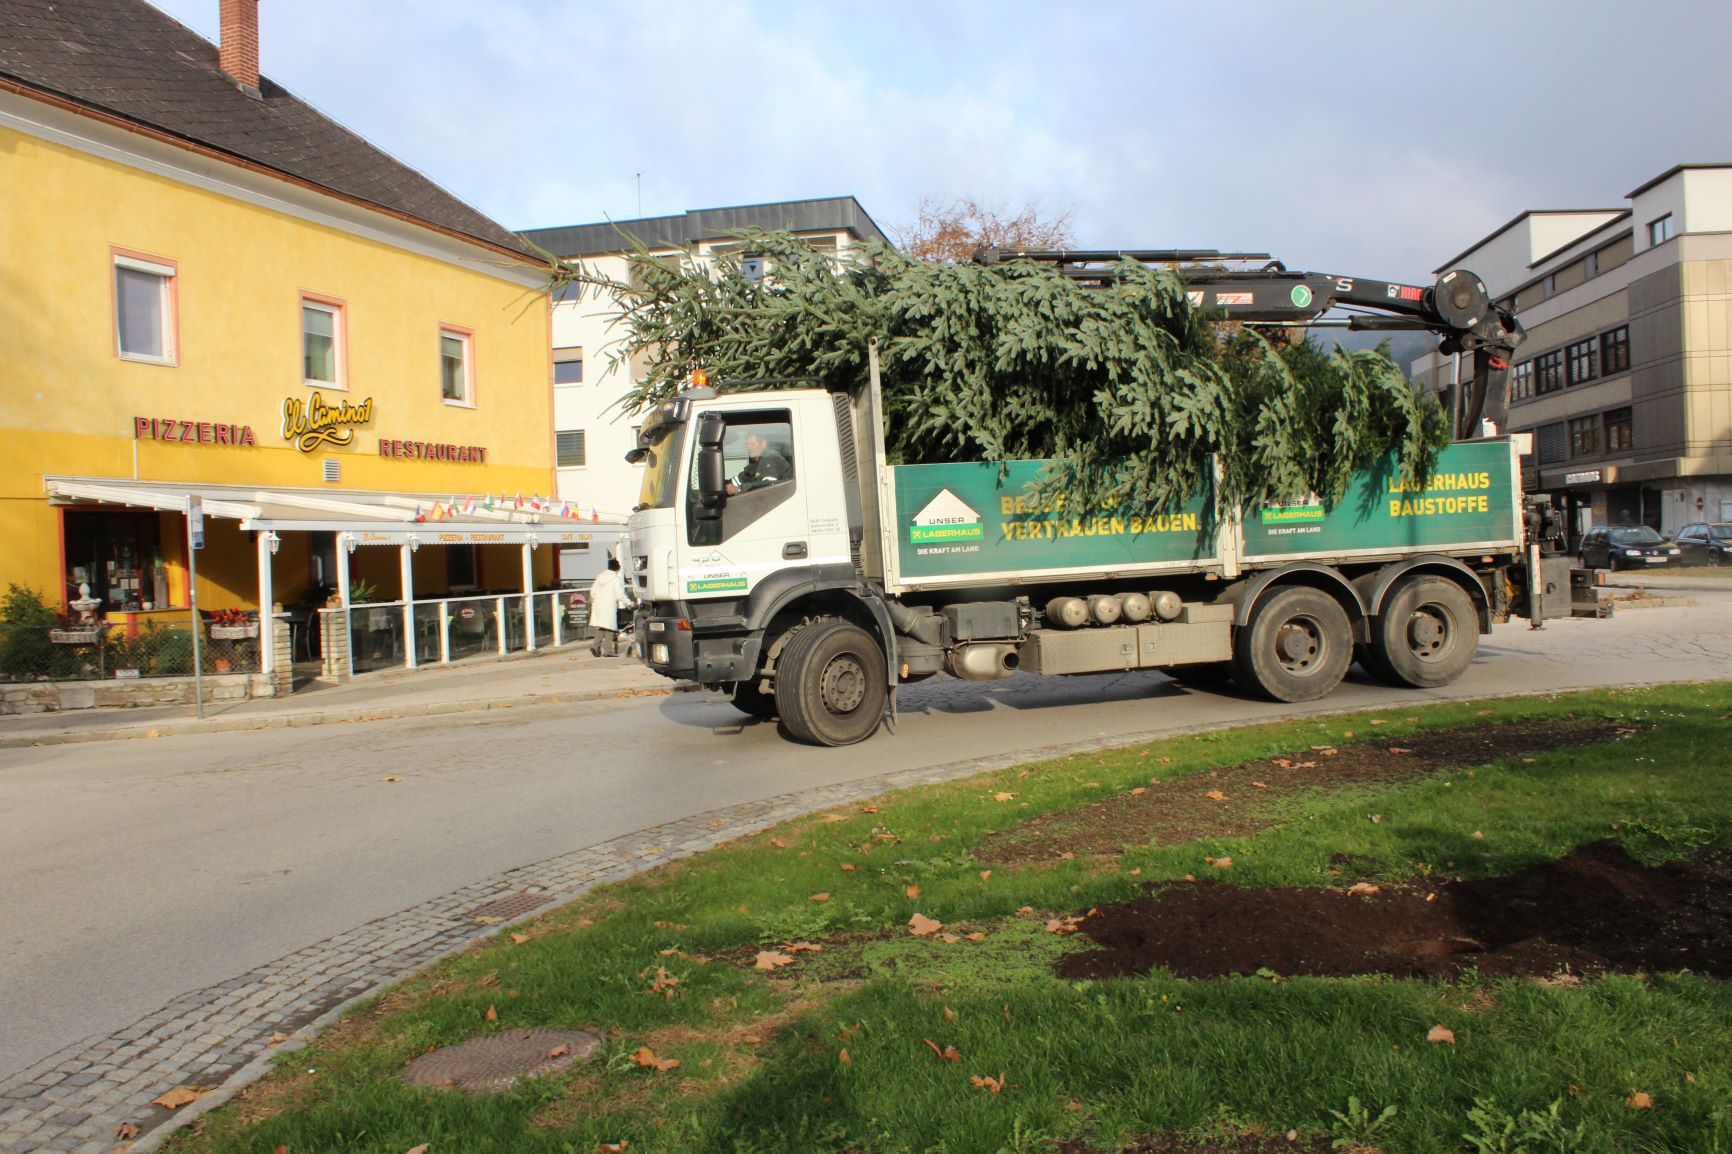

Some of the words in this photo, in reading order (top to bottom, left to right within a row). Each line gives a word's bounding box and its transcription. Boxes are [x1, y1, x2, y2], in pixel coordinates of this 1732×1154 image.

[282, 397, 307, 440] El
[134, 416, 257, 447] PIZZERIA
[378, 438, 489, 464] RESTAURANT
[1389, 496, 1489, 517] BAUSTOFFE
[929, 517, 965, 525] UNSER
[1001, 517, 1125, 540] VERTRAUEN
[1130, 513, 1202, 534] BAUEN.
[922, 528, 981, 538] LAGERHAUS
[929, 546, 950, 554] KRAFT
[962, 545, 979, 553] LAND
